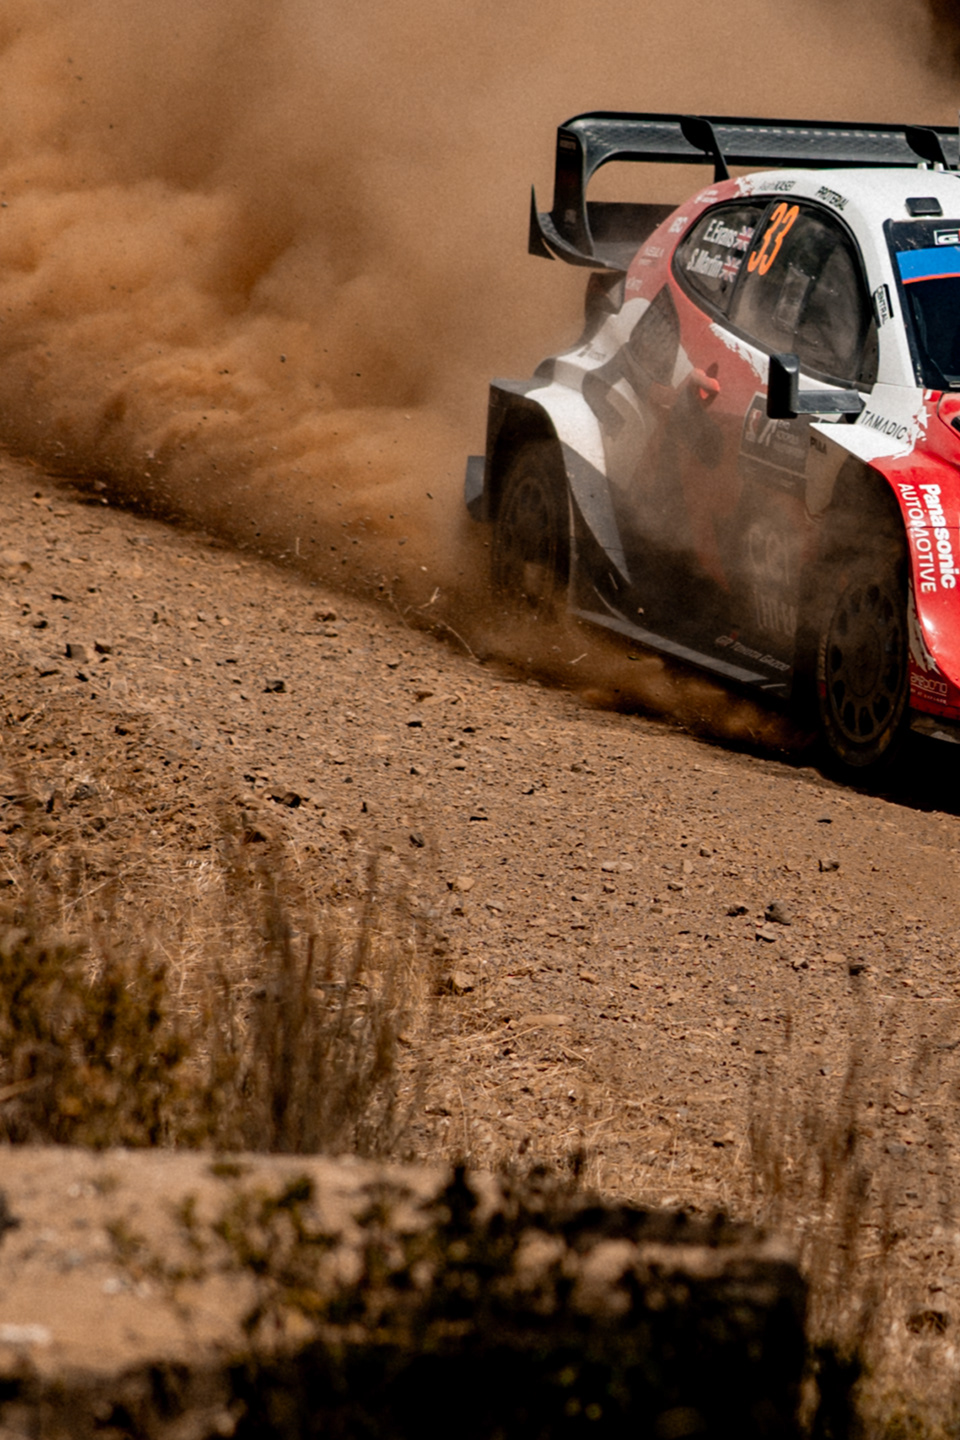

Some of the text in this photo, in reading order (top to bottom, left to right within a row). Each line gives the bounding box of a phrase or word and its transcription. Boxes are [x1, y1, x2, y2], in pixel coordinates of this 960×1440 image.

[747, 202, 799, 275] 33
[861, 410, 907, 440] TAMADIC
[897, 483, 937, 592] AUTOMOTIVE
[918, 483, 960, 589] Panasonic
